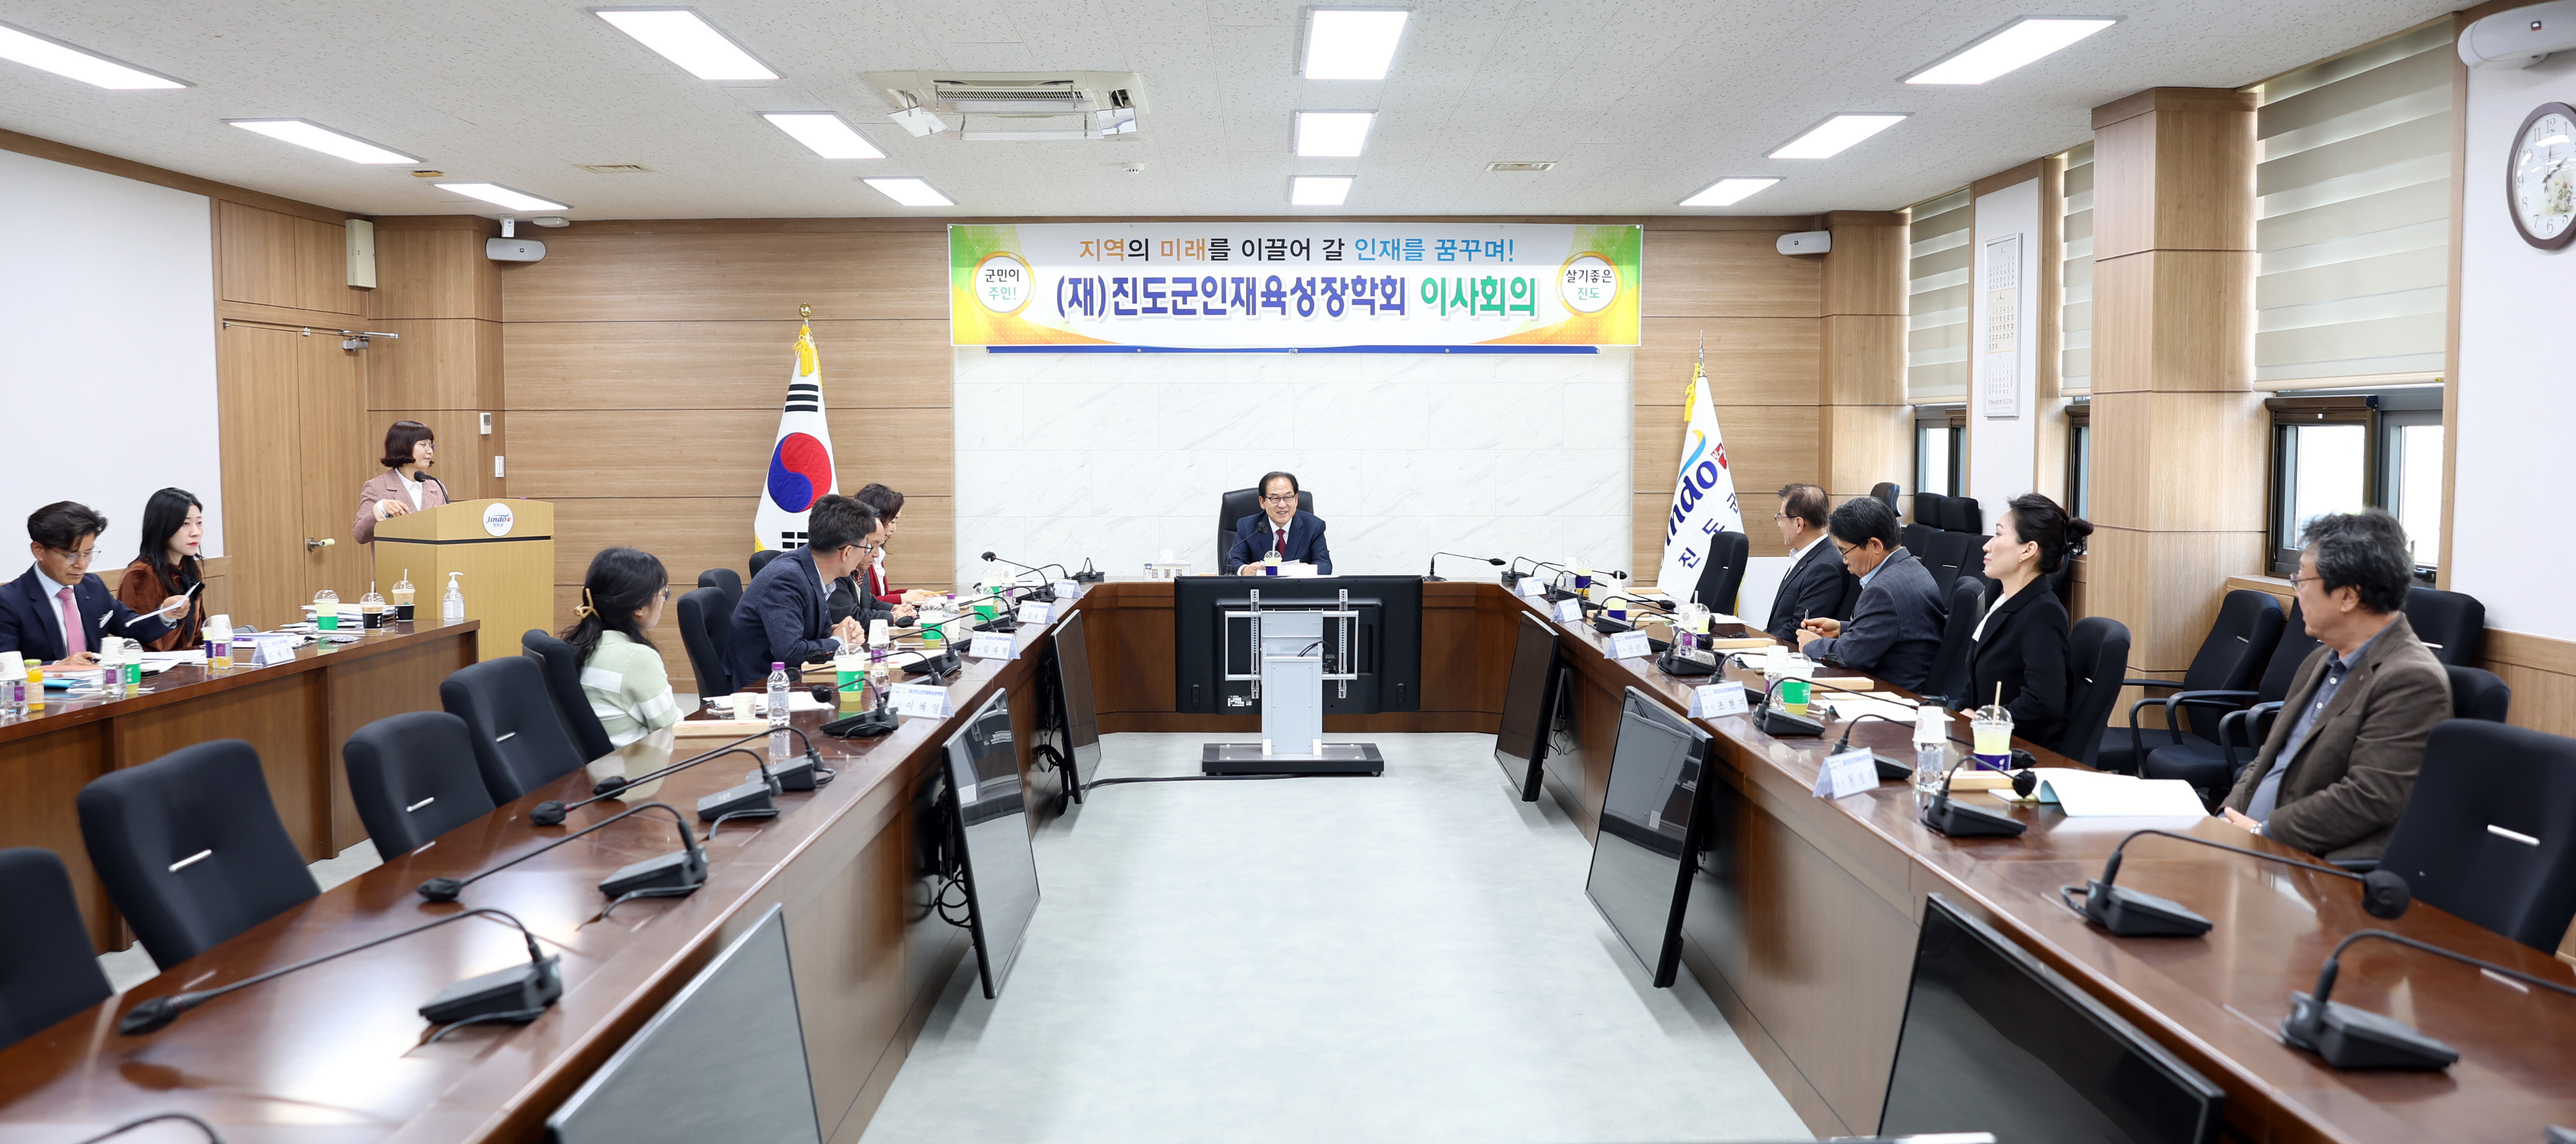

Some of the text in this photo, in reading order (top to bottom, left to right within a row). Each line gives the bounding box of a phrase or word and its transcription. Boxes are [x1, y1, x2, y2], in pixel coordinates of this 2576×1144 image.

[2546, 118, 2556, 134] 12
[2534, 127, 2541, 142] 11
[2517, 173, 2524, 188] 9
[2521, 196, 2528, 211] 8
[2534, 213, 2539, 228] 7
[2547, 218, 2554, 234] 6
[1079, 238, 1514, 262] 지역의 미래를 이끌어 갈 인재를 꿈꾸며!
[985, 269, 1019, 282] 군민이
[1566, 269, 1612, 284] 살기좋은
[988, 286, 1017, 301] 주인!
[1056, 275, 1536, 317] (재)진도군인재육성장학회 이사회의
[1578, 287, 1601, 301] 진도
[1660, 461, 1717, 571] indo
